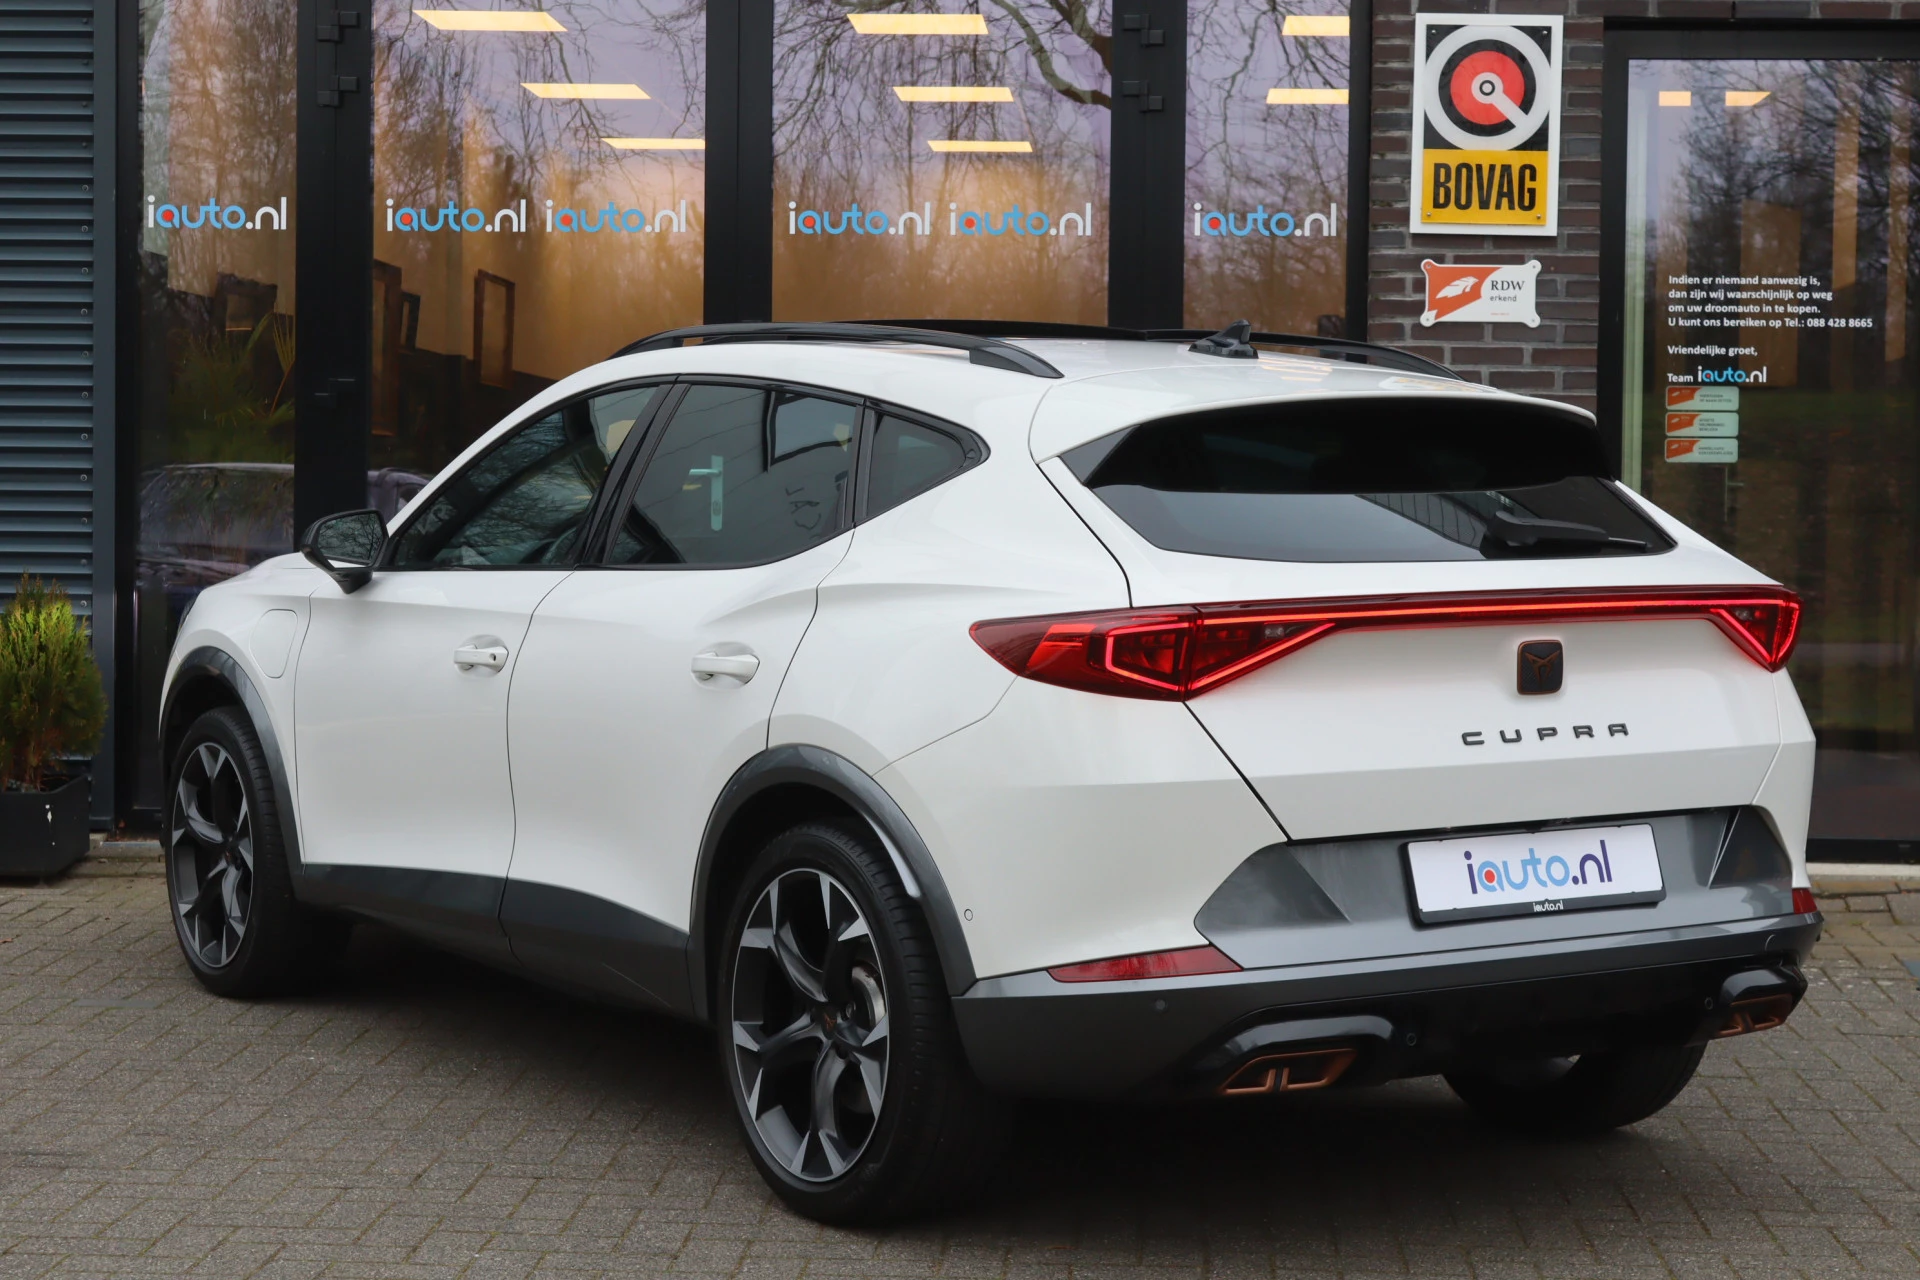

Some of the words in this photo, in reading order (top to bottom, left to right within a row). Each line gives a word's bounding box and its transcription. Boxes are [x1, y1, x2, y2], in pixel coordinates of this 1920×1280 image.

[1432, 162, 1537, 212] BOVAG
[148, 195, 287, 230] iauto.nl
[386, 198, 526, 232] iauto.nl
[546, 199, 686, 232] iauto.nl
[789, 201, 930, 235] iauto.nl
[950, 202, 1091, 236] iauto.nl
[1193, 202, 1337, 237] iauto.nl
[1490, 280, 1525, 291] RDW
[1668, 275, 1700, 285] Indien
[1702, 277, 1713, 285] er
[1715, 275, 1759, 285] niemand
[1761, 276, 1807, 287] aanwezig
[1809, 276, 1821, 287] is,
[1668, 289, 1687, 299] dan
[1690, 289, 1707, 301] zijn
[1709, 289, 1725, 301] wij
[1727, 289, 1794, 301] waarschijnlijk
[1796, 292, 1809, 301] op
[1811, 292, 1833, 302] weg
[1668, 305, 1685, 313] om
[1687, 305, 1702, 313] uw
[1704, 303, 1760, 313] droomauto
[1762, 304, 1772, 313] in
[1774, 304, 1785, 313] te
[1786, 304, 1821, 315] kopen.
[1668, 317, 1677, 327] U
[1678, 317, 1701, 327] kunt
[1703, 319, 1721, 327] ons
[1723, 317, 1766, 327] bereiken
[1768, 320, 1782, 329] op
[1784, 318, 1805, 327] Tel.:
[1807, 318, 1825, 327] 088
[1827, 318, 1846, 327] 428
[1848, 318, 1873, 327] 8665
[1667, 345, 1727, 356] Vriendelijke
[1728, 346, 1758, 356] groet,
[1667, 373, 1694, 382] Team
[1697, 366, 1767, 382] iauto.nl
[1462, 723, 1629, 746] CUPRA
[1463, 839, 1612, 894] iauto.nl
[1533, 900, 1564, 912] iauto.nl
